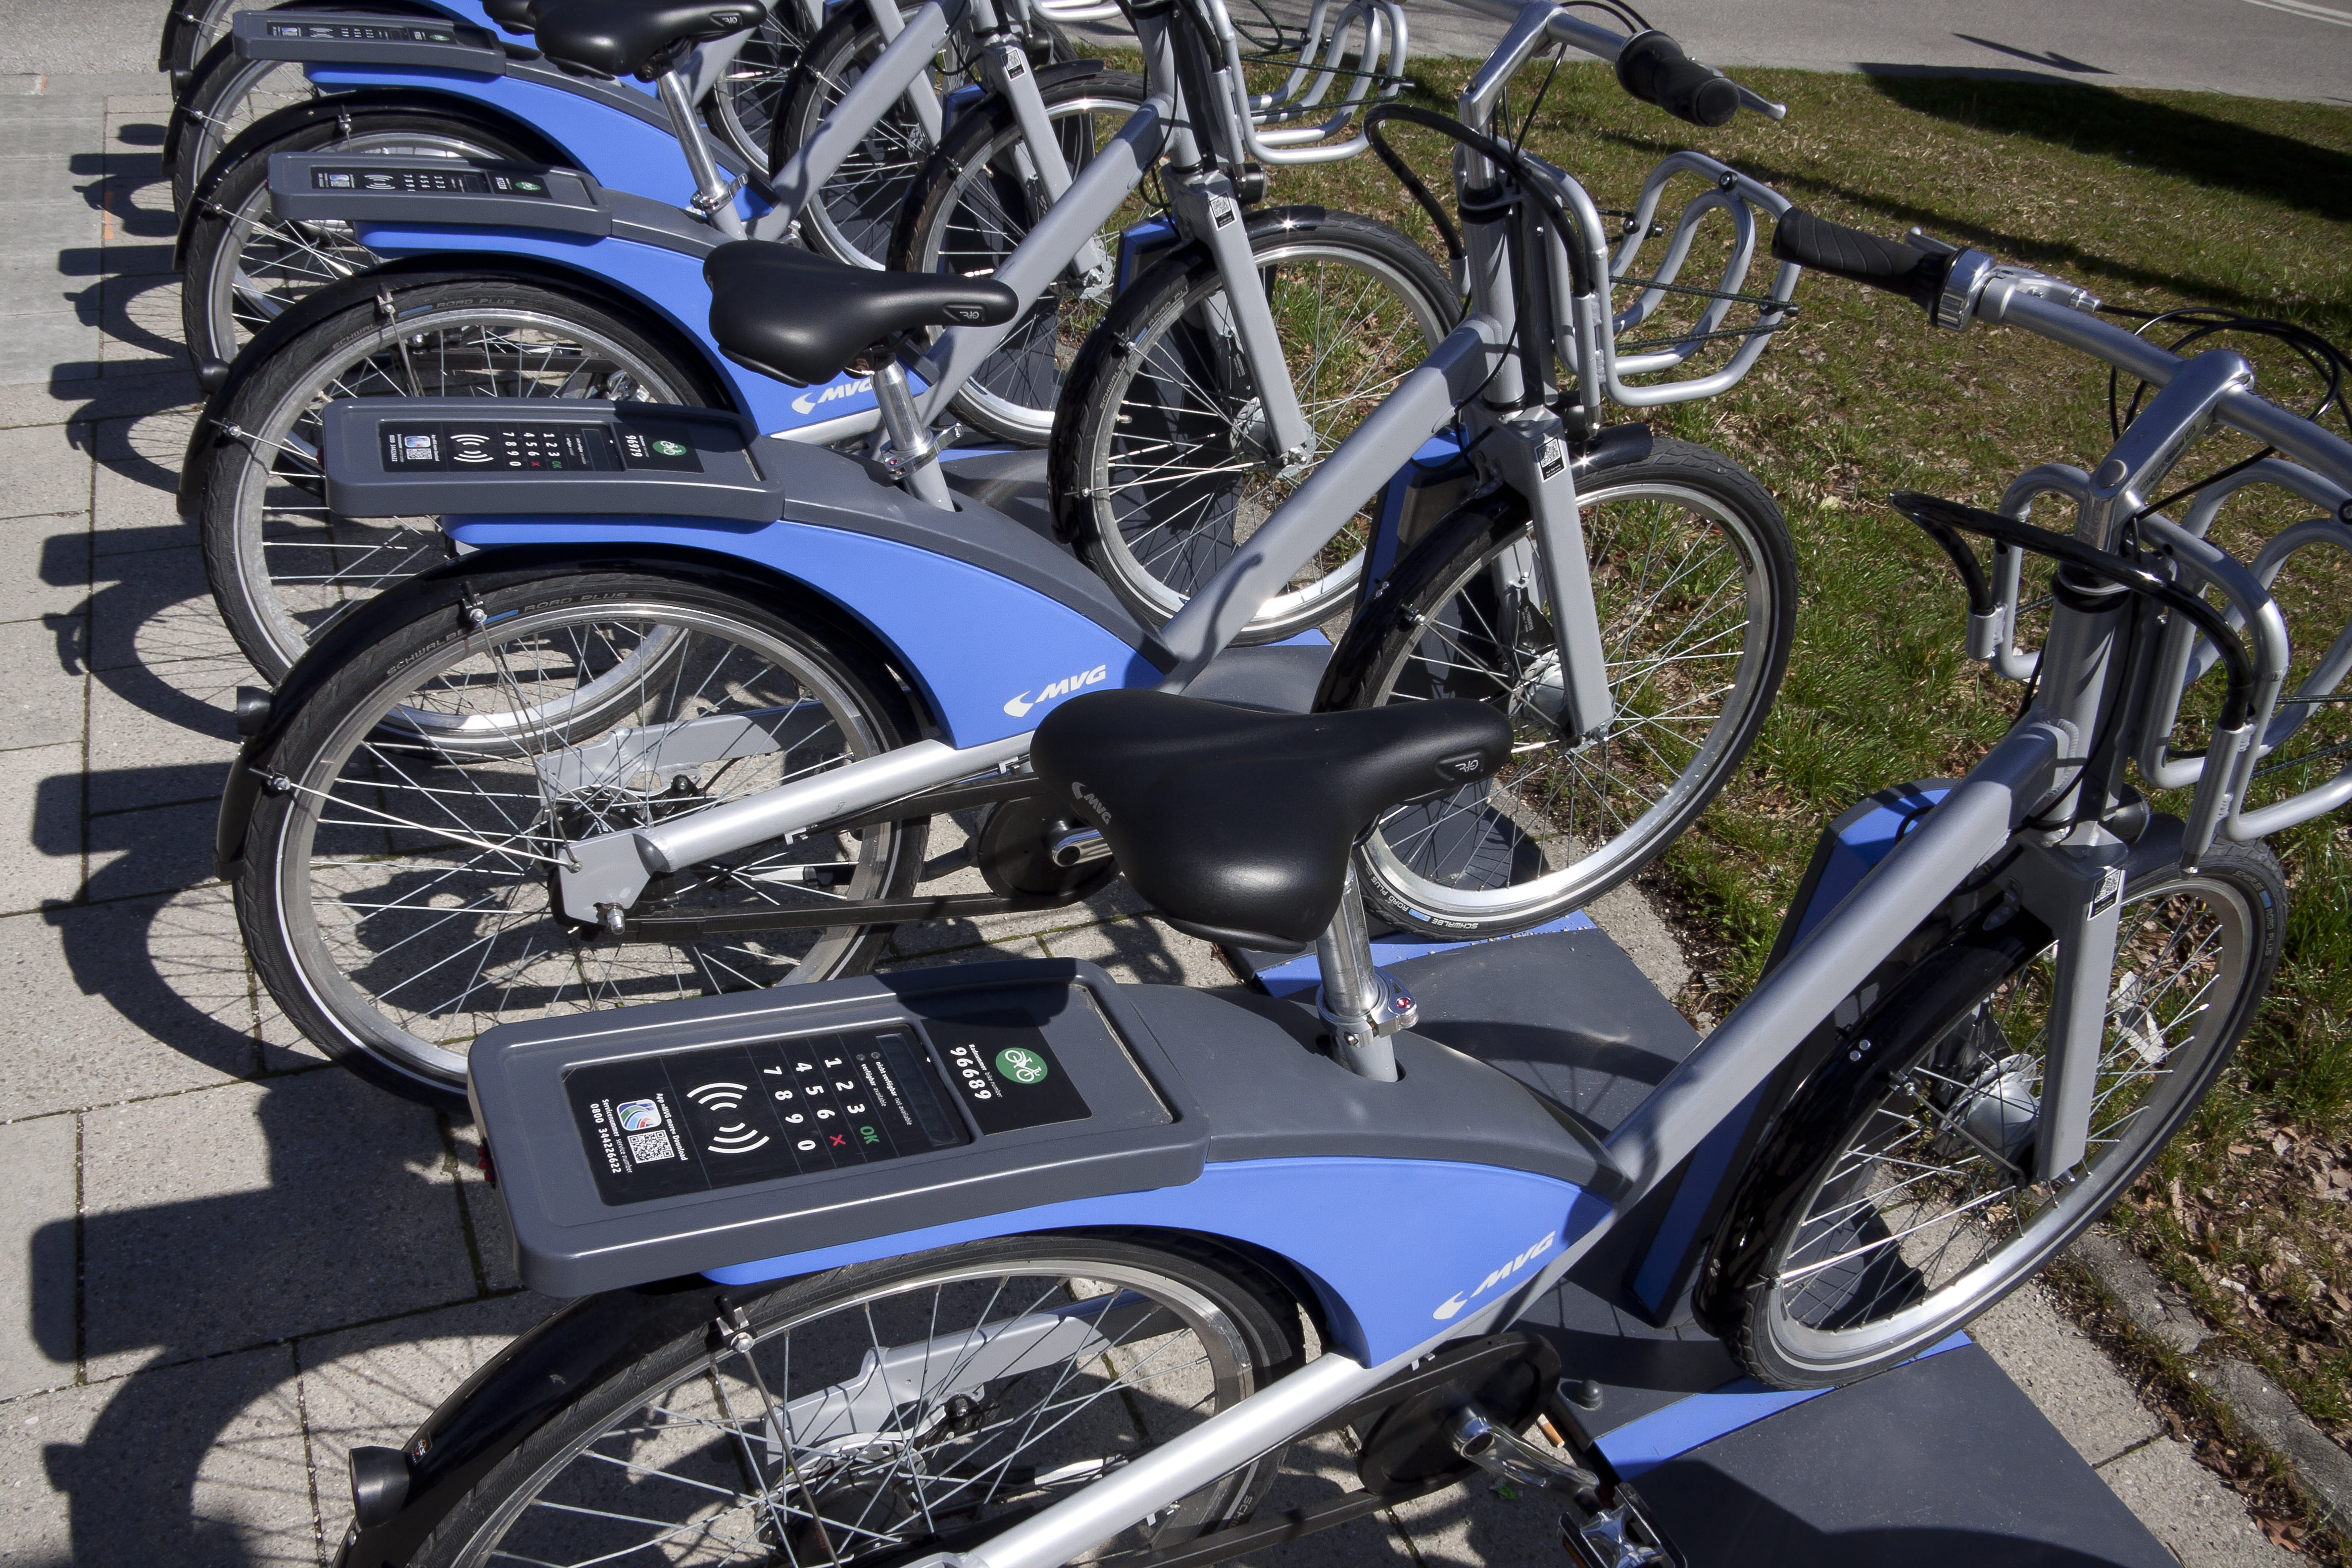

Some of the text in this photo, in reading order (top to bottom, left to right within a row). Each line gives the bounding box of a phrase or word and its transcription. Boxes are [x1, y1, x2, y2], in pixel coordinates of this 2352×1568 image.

[817, 377, 873, 404] MVG
[625, 435, 642, 457] 96979
[386, 592, 628, 676] SCHWALBE ROAD PLUS
[1034, 664, 1106, 703] MVG
[1083, 793, 1112, 825] MVG
[1371, 876, 1479, 930] SCHWALBE ROAD PLUS
[2265, 908, 2274, 930] ROAD
[2264, 932, 2274, 956] PLUS
[950, 1047, 992, 1099] 96689
[969, 1044, 987, 1071] Radnummer
[764, 1066, 816, 1150] 7 8 9 0
[795, 1062, 835, 1119] 4 5 6
[825, 1058, 880, 1144] 1 2 3 OK
[861, 1063, 887, 1107] verfügbar available
[876, 1061, 886, 1076] nicht
[882, 1075, 897, 1097] verfügbar
[898, 1105, 913, 1126] available
[590, 1103, 622, 1174] 0800 344226622
[602, 1099, 633, 1174] Servicenummer service number
[656, 1093, 665, 1104] App
[673, 1135, 688, 1161] Download
[1470, 1230, 1556, 1298] MVG
